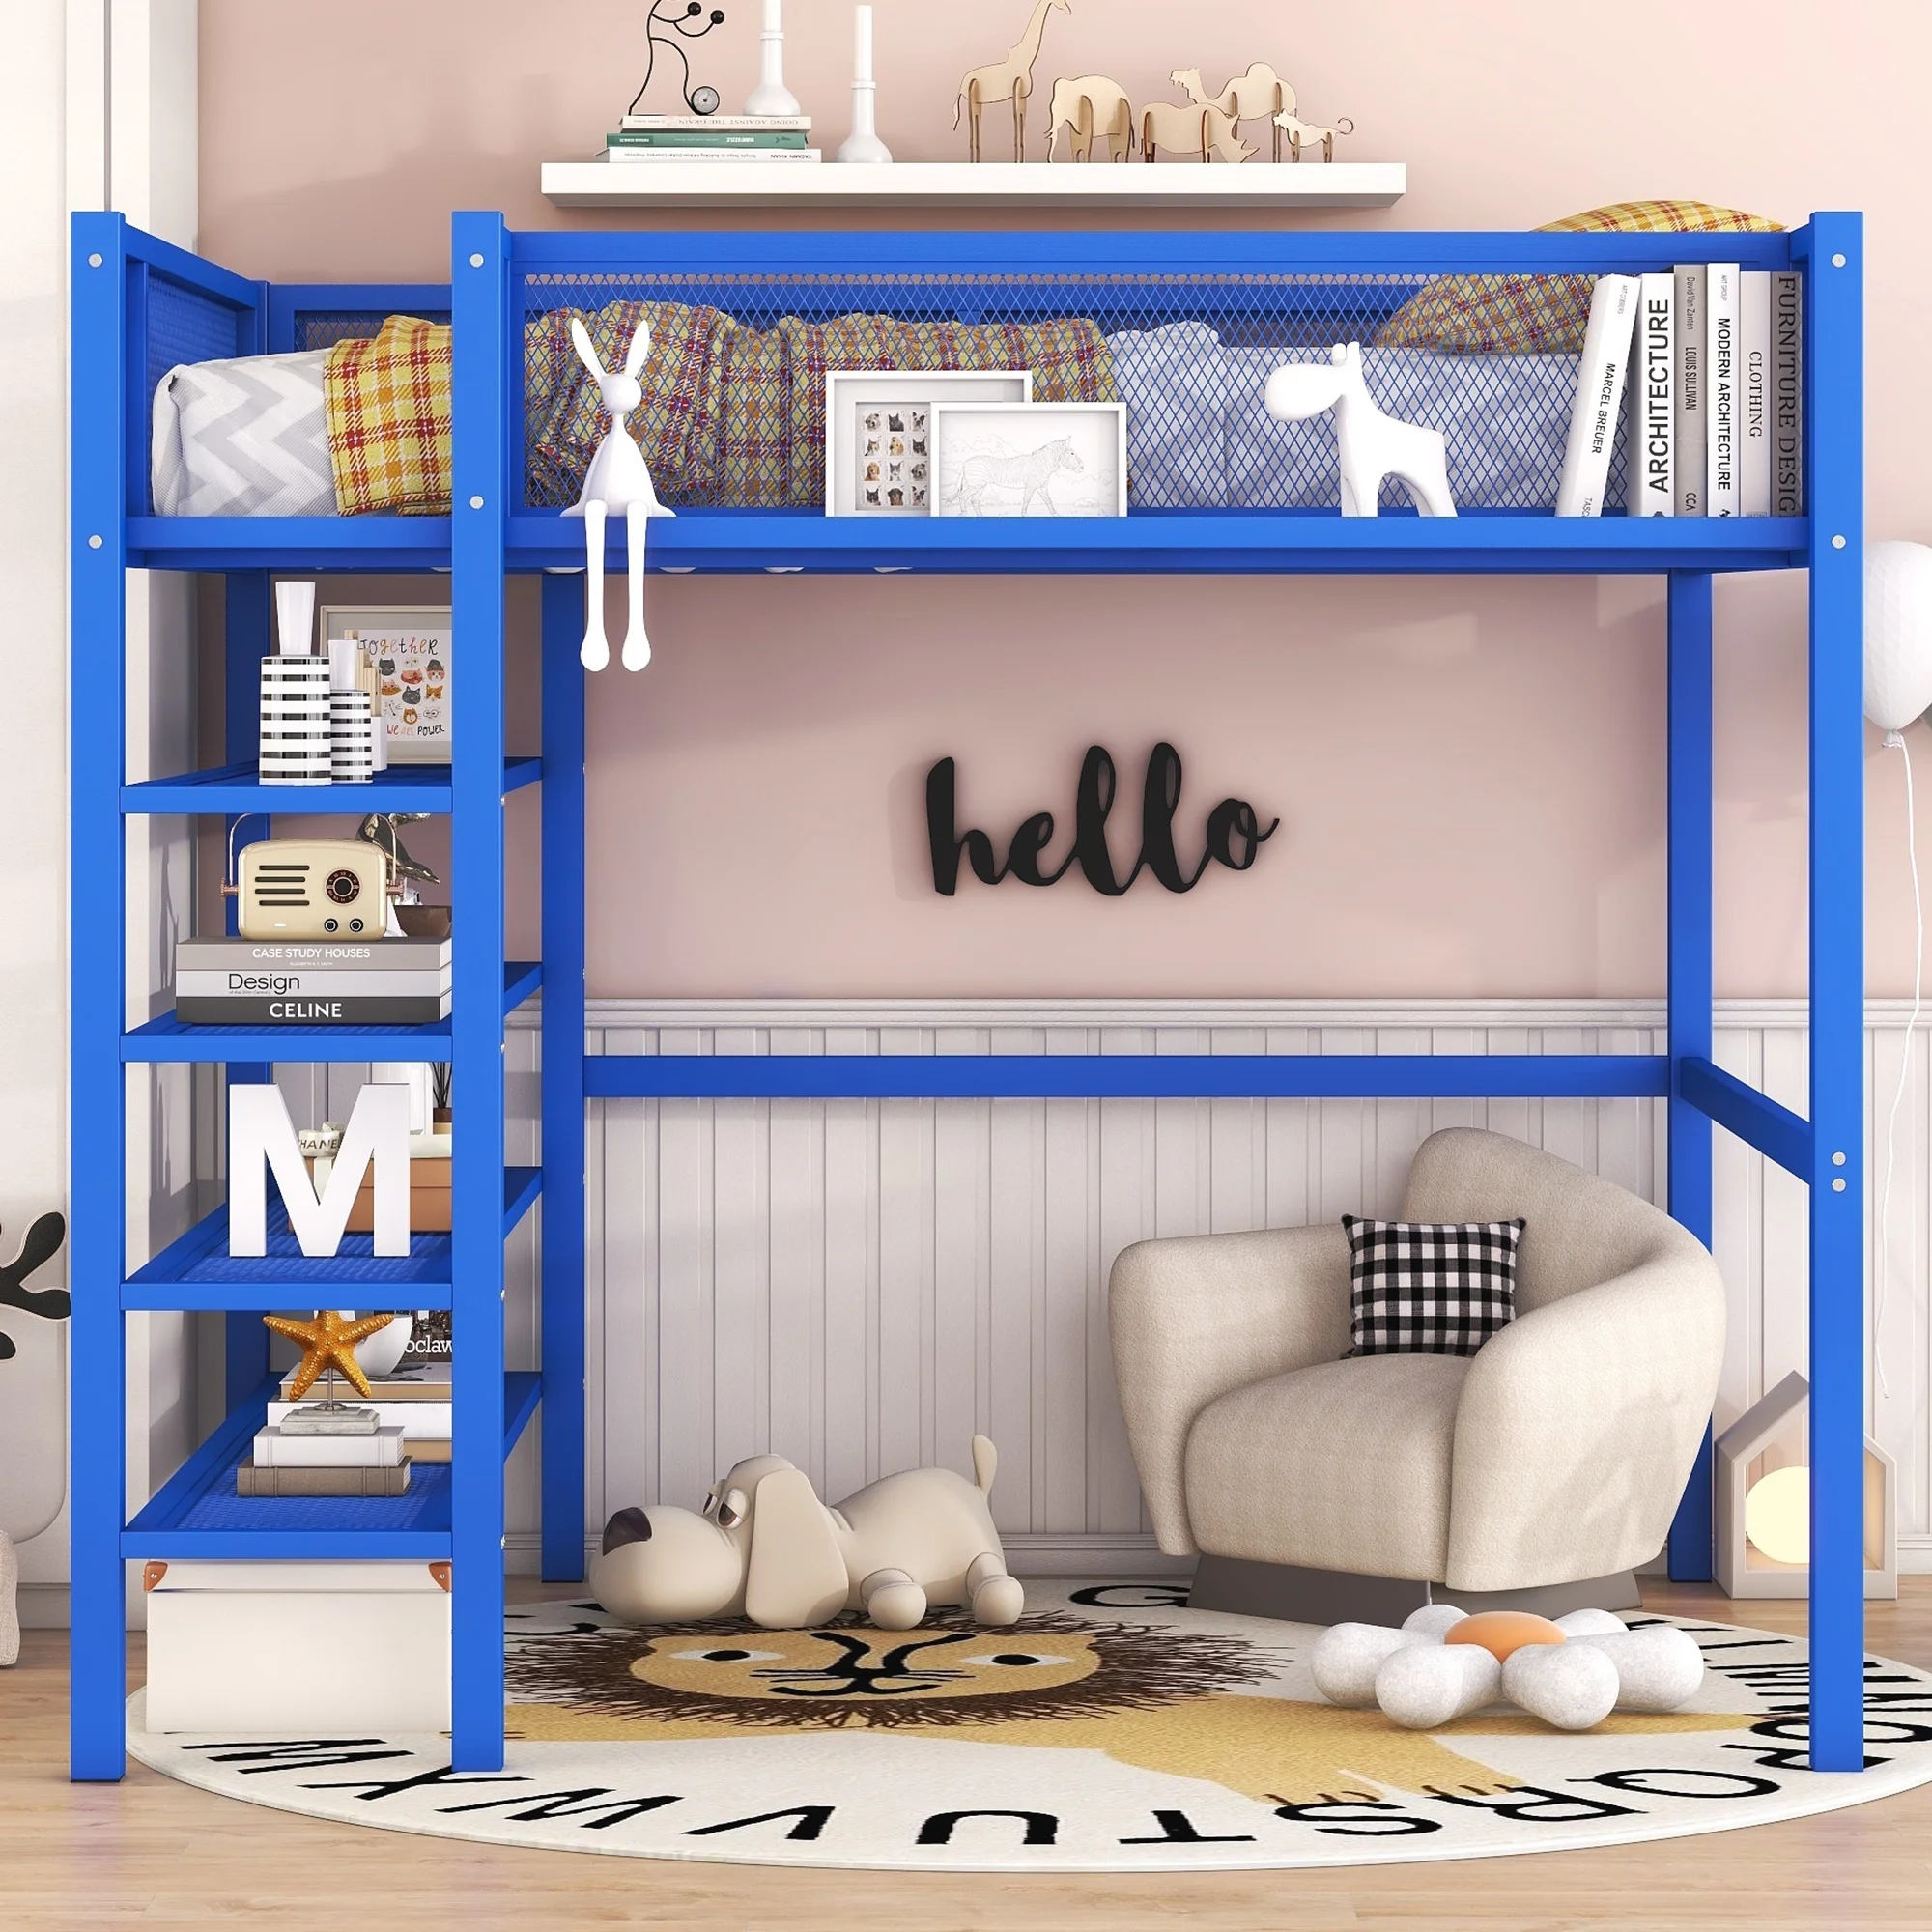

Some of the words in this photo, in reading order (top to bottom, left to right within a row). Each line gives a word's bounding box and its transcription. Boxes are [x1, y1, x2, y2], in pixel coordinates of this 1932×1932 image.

[1685, 347, 1697, 371] LOUIS
[1718, 318, 1731, 378] MODERN
[1778, 276, 1796, 428] FURNITURE
[1600, 361, 1617, 408] MARCEL
[1648, 299, 1668, 493] ARCHITECTURE
[1685, 372, 1697, 411] SULLIVAN
[1748, 351, 1763, 438] CLOTHING
[1591, 409, 1609, 454] BREUER
[1718, 382, 1731, 491] ARCHITECTURE
[1778, 436, 1796, 516] DESIG
[926, 743, 1279, 895] hello
[252, 947, 283, 958] CASE
[286, 947, 322, 958] STUDY
[325, 947, 371, 958] HOUSES
[229, 973, 300, 996] Design
[270, 1002, 342, 1018] CELINE
[229, 1082, 411, 1258] M
